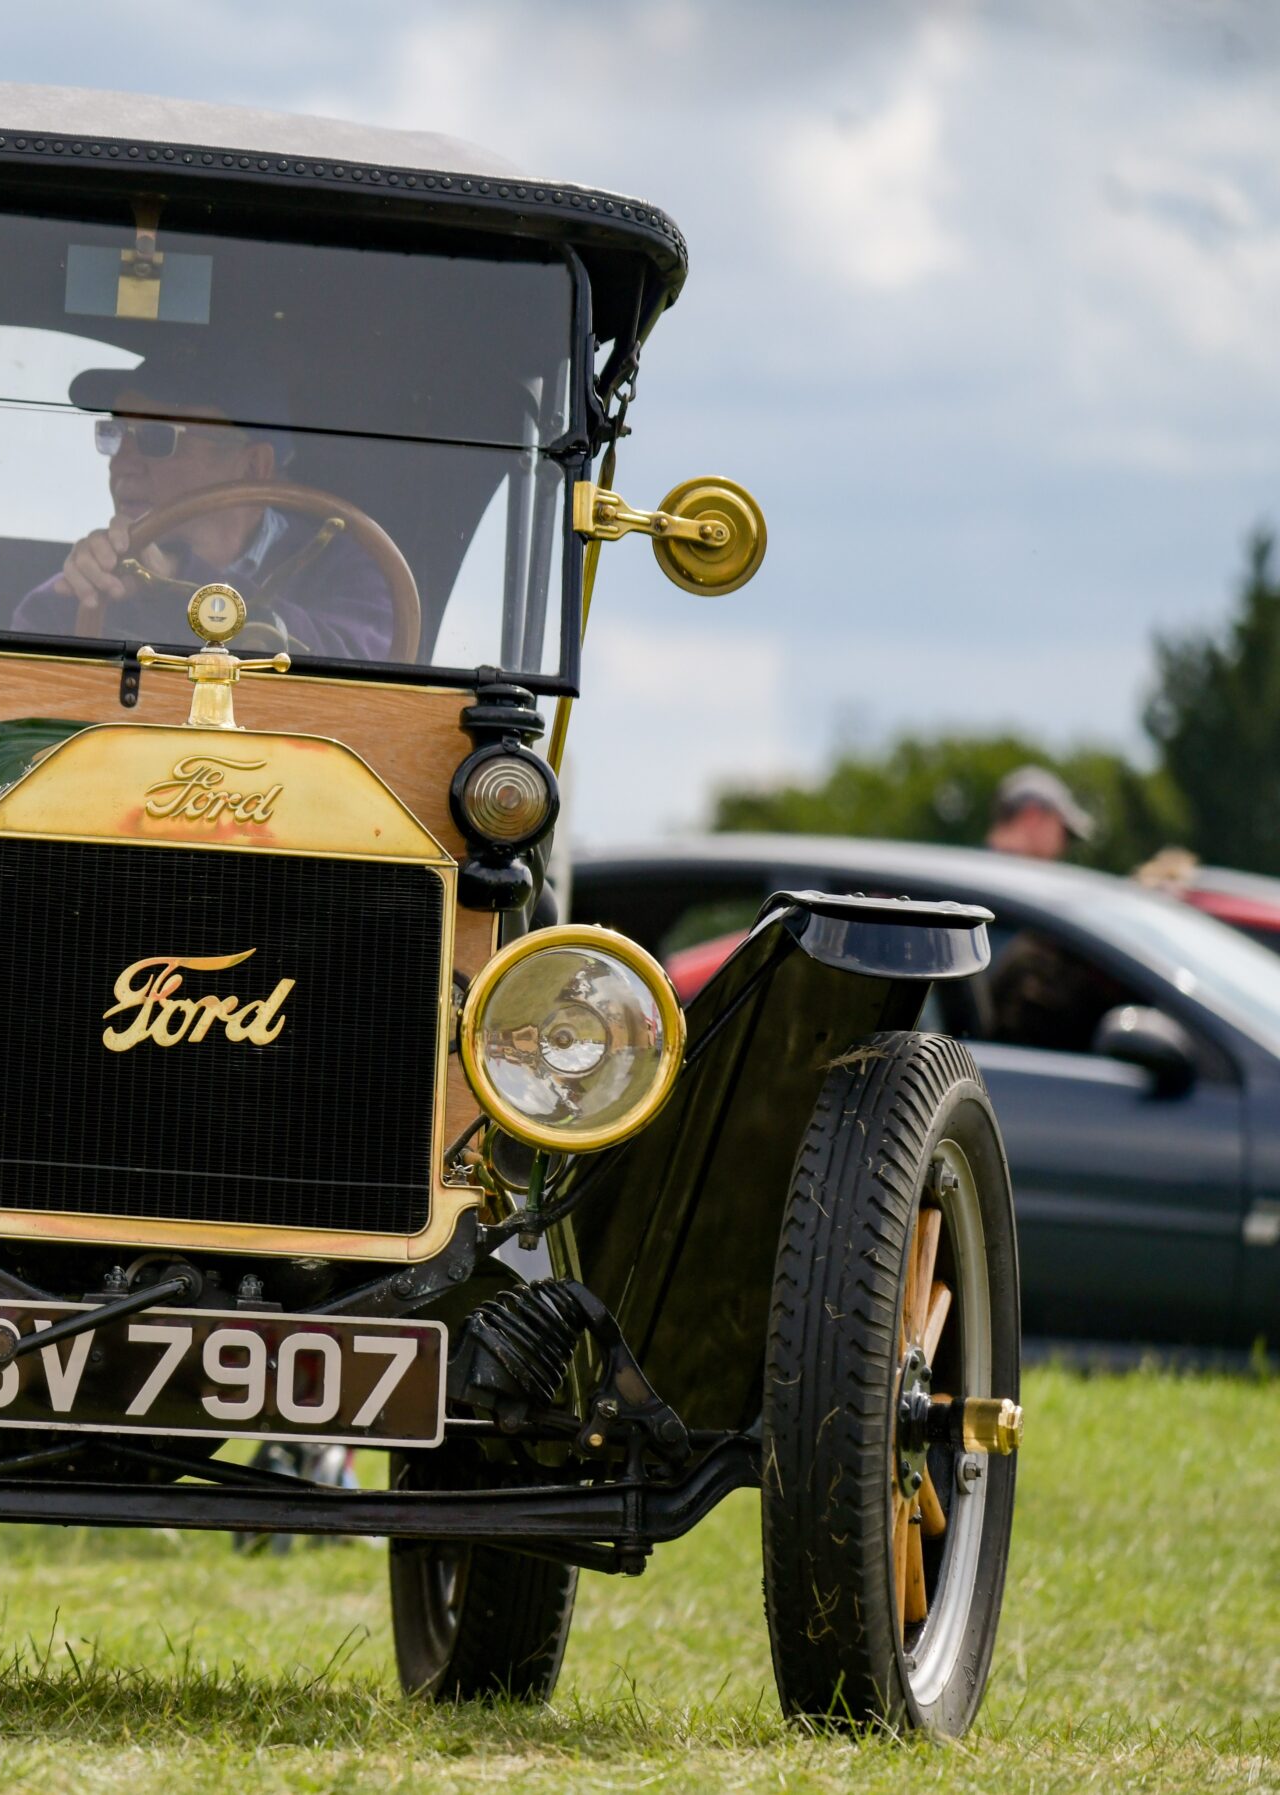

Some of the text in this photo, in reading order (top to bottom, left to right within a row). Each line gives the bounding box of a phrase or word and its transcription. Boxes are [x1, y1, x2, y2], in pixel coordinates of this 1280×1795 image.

[145, 755, 284, 824] Ford
[102, 947, 296, 1052] Ford
[125, 1324, 418, 1427] 7907
